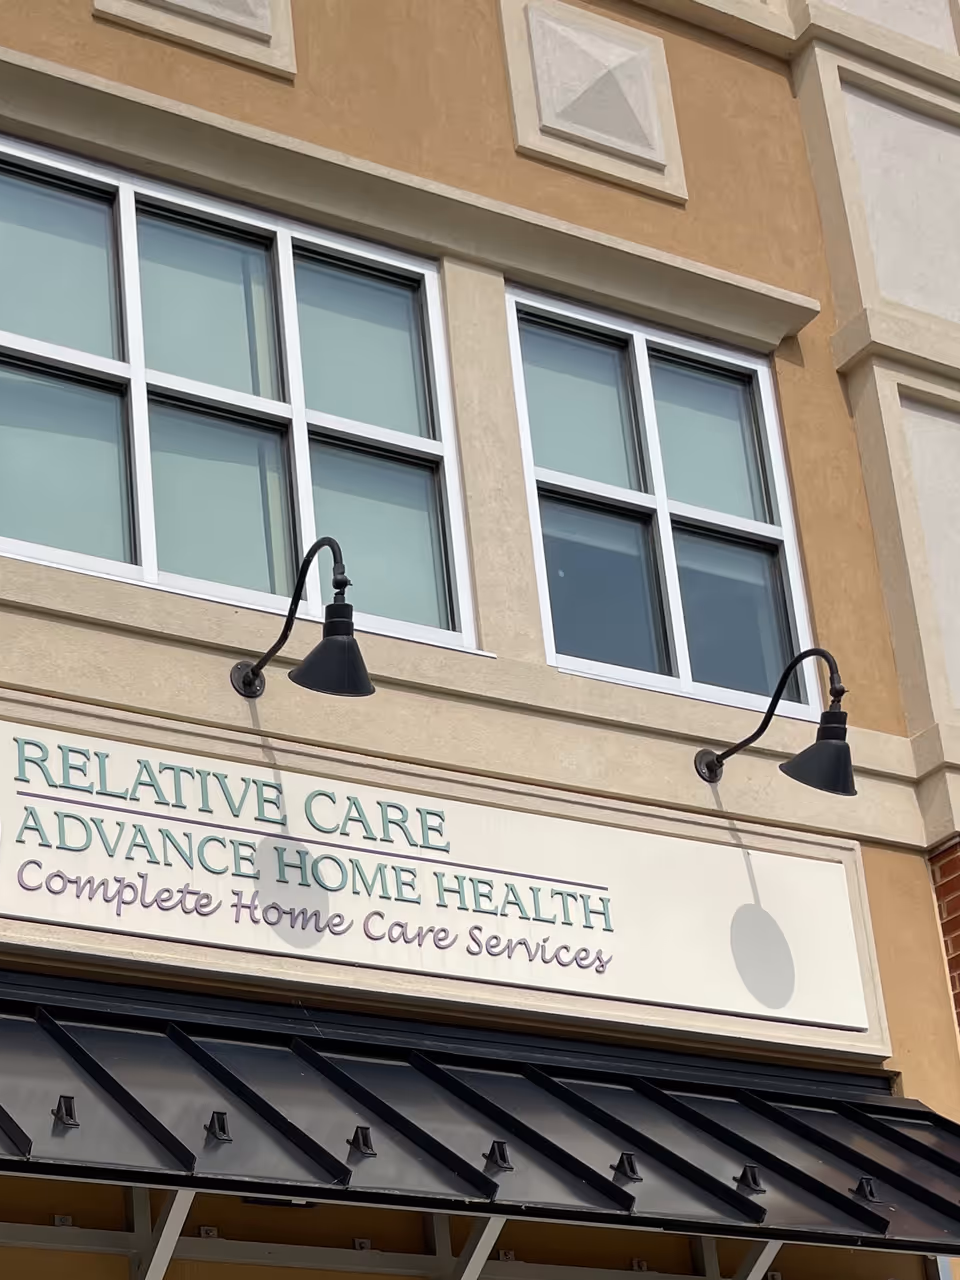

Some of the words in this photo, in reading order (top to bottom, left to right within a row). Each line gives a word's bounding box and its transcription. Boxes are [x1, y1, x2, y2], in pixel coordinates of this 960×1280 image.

[13, 736, 287, 826] RELATIVE
[304, 789, 451, 854] CARE
[15, 805, 260, 880] ADVANCE
[273, 846, 422, 905] HOME
[433, 870, 615, 933] HEALTH
[17, 859, 223, 917] Complete
[230, 889, 354, 936] Home
[363, 910, 459, 950] Care
[466, 924, 614, 974] Services
